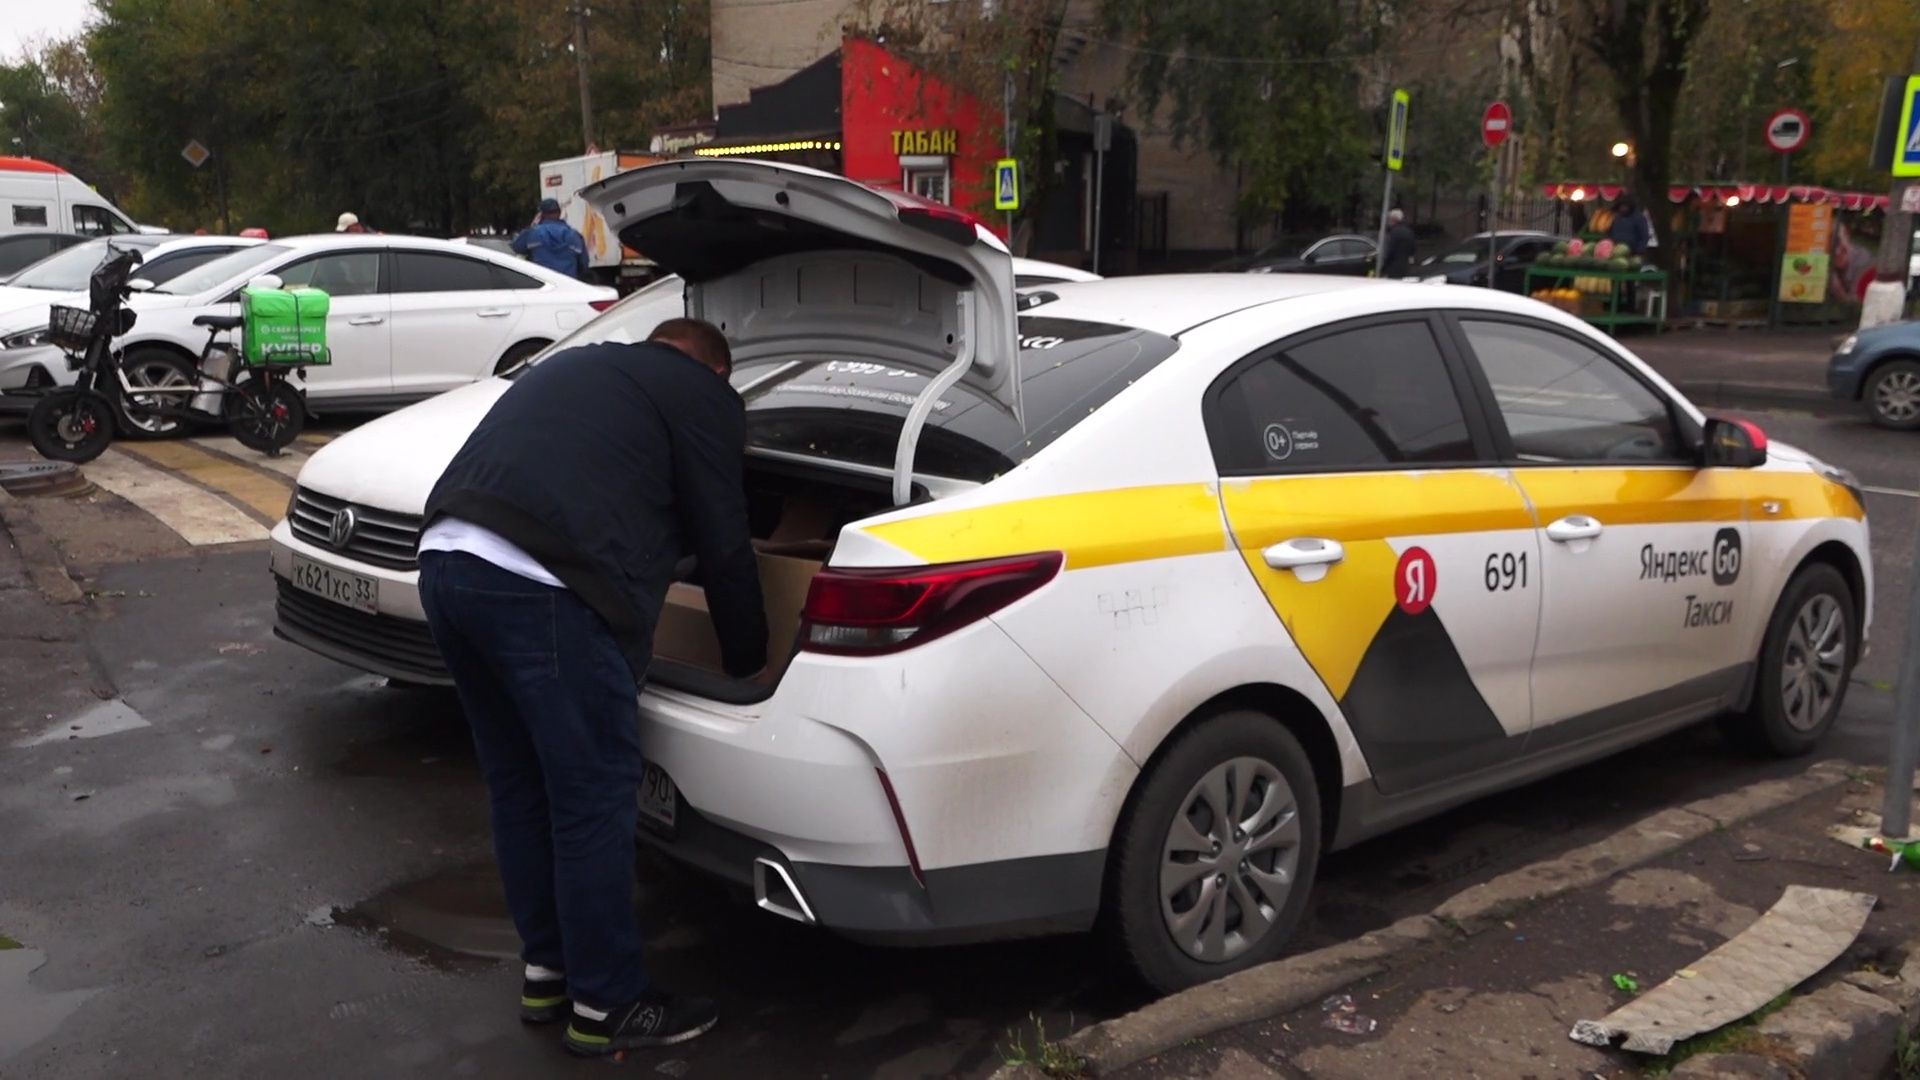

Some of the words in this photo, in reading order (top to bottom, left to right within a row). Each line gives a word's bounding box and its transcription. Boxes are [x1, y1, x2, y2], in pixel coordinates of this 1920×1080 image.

[891, 130, 957, 155] ТАБАК
[1485, 552, 1527, 592] 691
[1639, 543, 1708, 583] Яндекс
[1715, 538, 1740, 576] Go
[1405, 558, 1424, 604] Я
[1684, 594, 1733, 628] Такси
